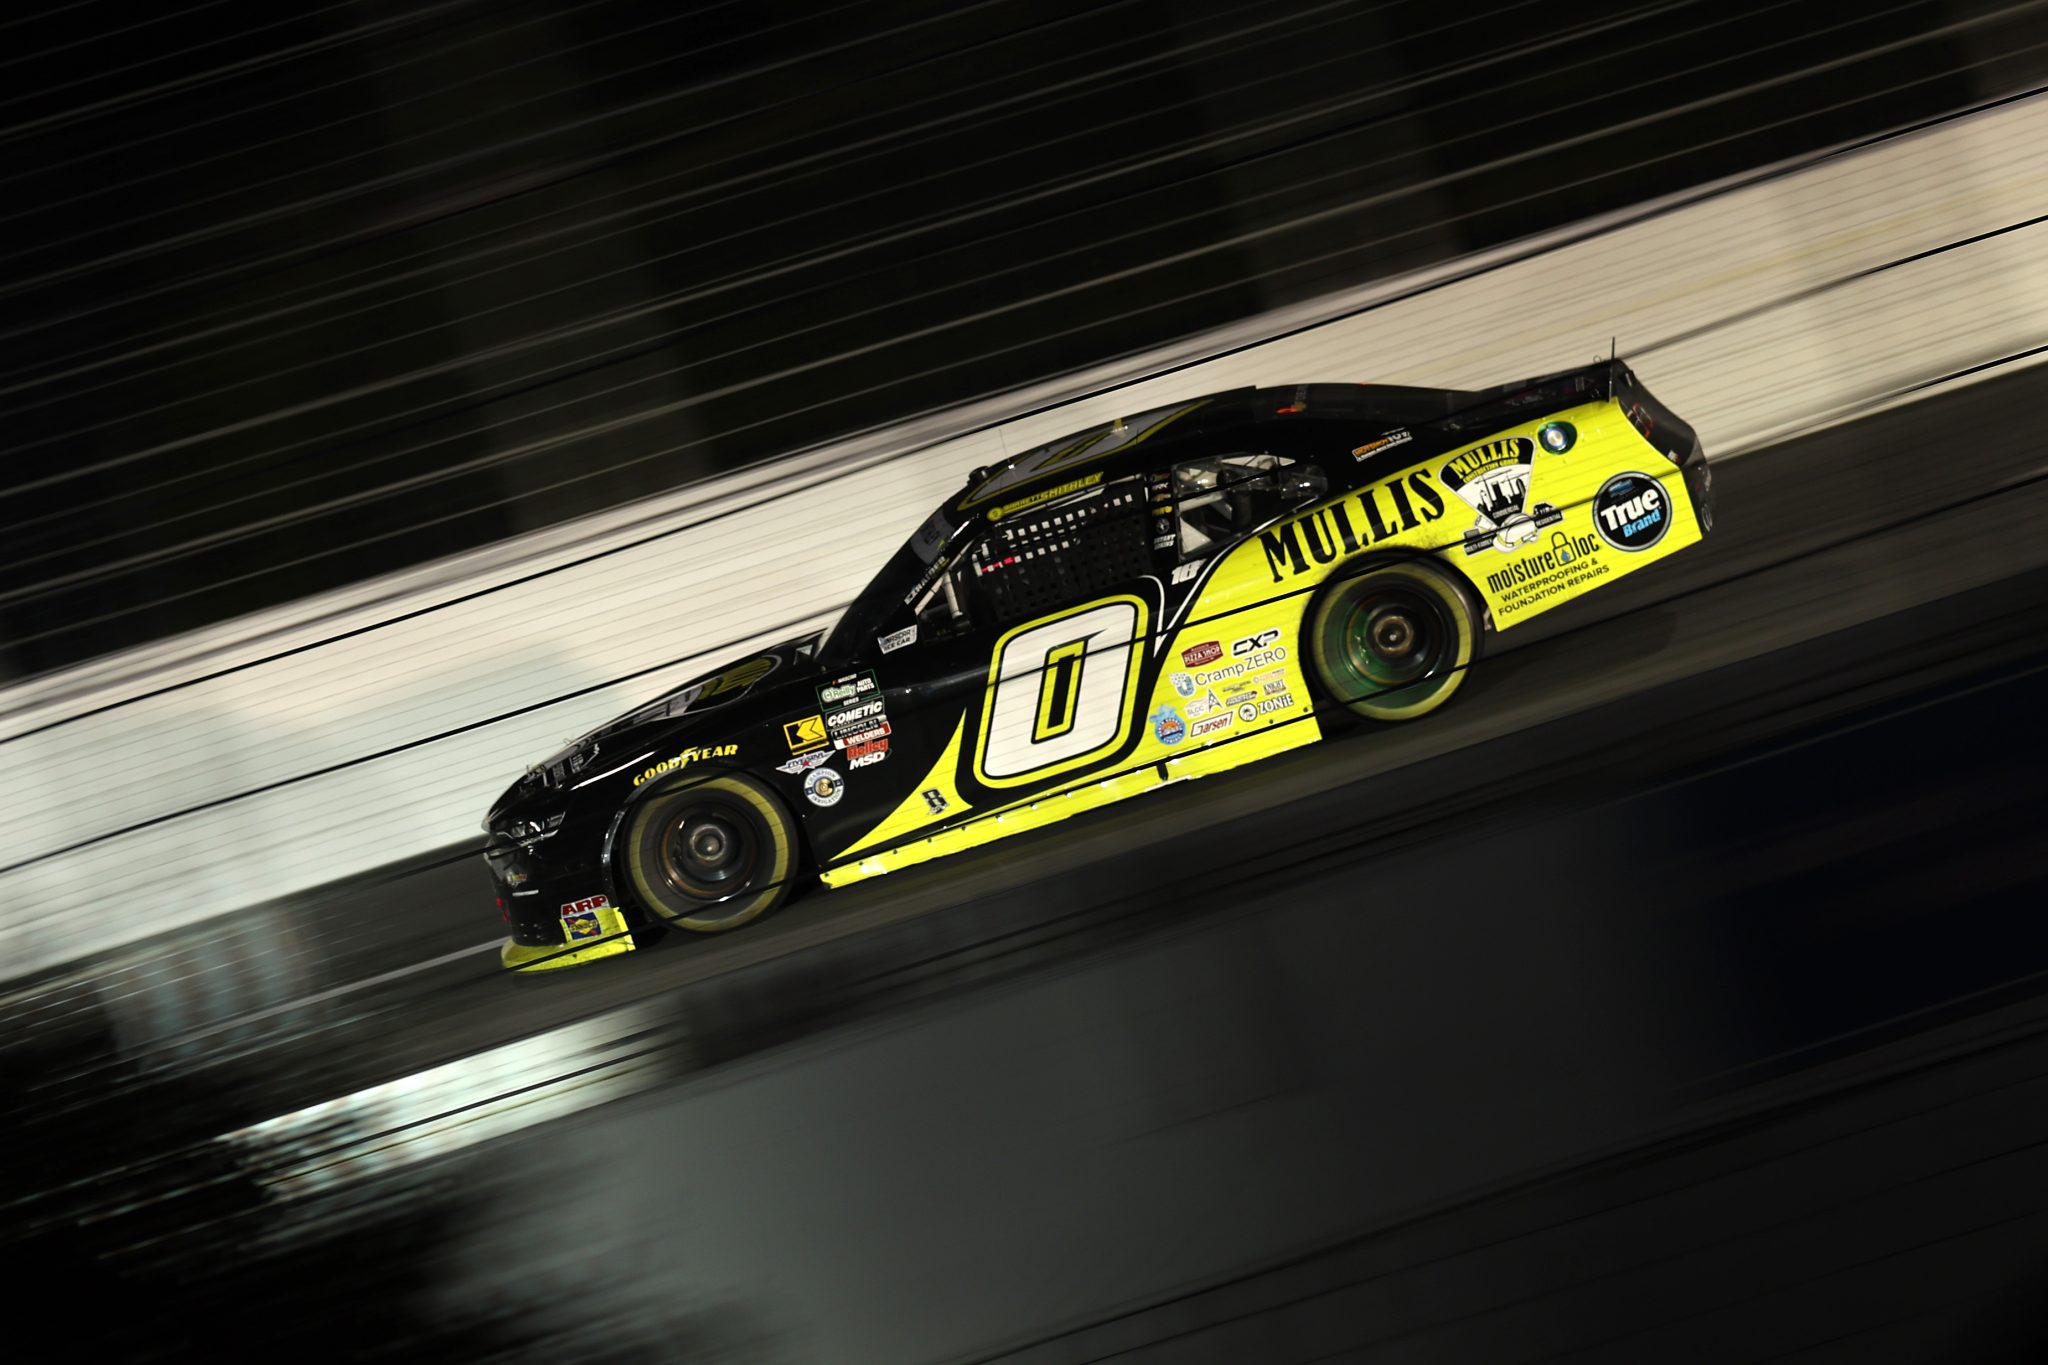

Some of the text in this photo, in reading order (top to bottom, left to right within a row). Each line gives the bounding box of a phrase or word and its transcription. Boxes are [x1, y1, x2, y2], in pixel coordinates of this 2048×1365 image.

[1448, 439, 1521, 479] MULLIS
[1258, 468, 1445, 583] MULLIS
[1600, 489, 1660, 531] True
[1622, 508, 1661, 538] Brand
[1486, 533, 1600, 594] moisture loc
[1501, 557, 1598, 602] WATERPROOFING &
[1498, 564, 1610, 616] FOUNDATION REPAIRS
[857, 682, 875, 693] PARTS
[974, 595, 1148, 788] 0
[828, 701, 882, 727] COMETIC
[834, 719, 879, 739] LINCOLN
[847, 727, 886, 745] WELDERS
[847, 739, 889, 760] Holley
[633, 744, 738, 786] GOODYEAR
[849, 752, 886, 770] MSD
[562, 896, 607, 915] ARP
